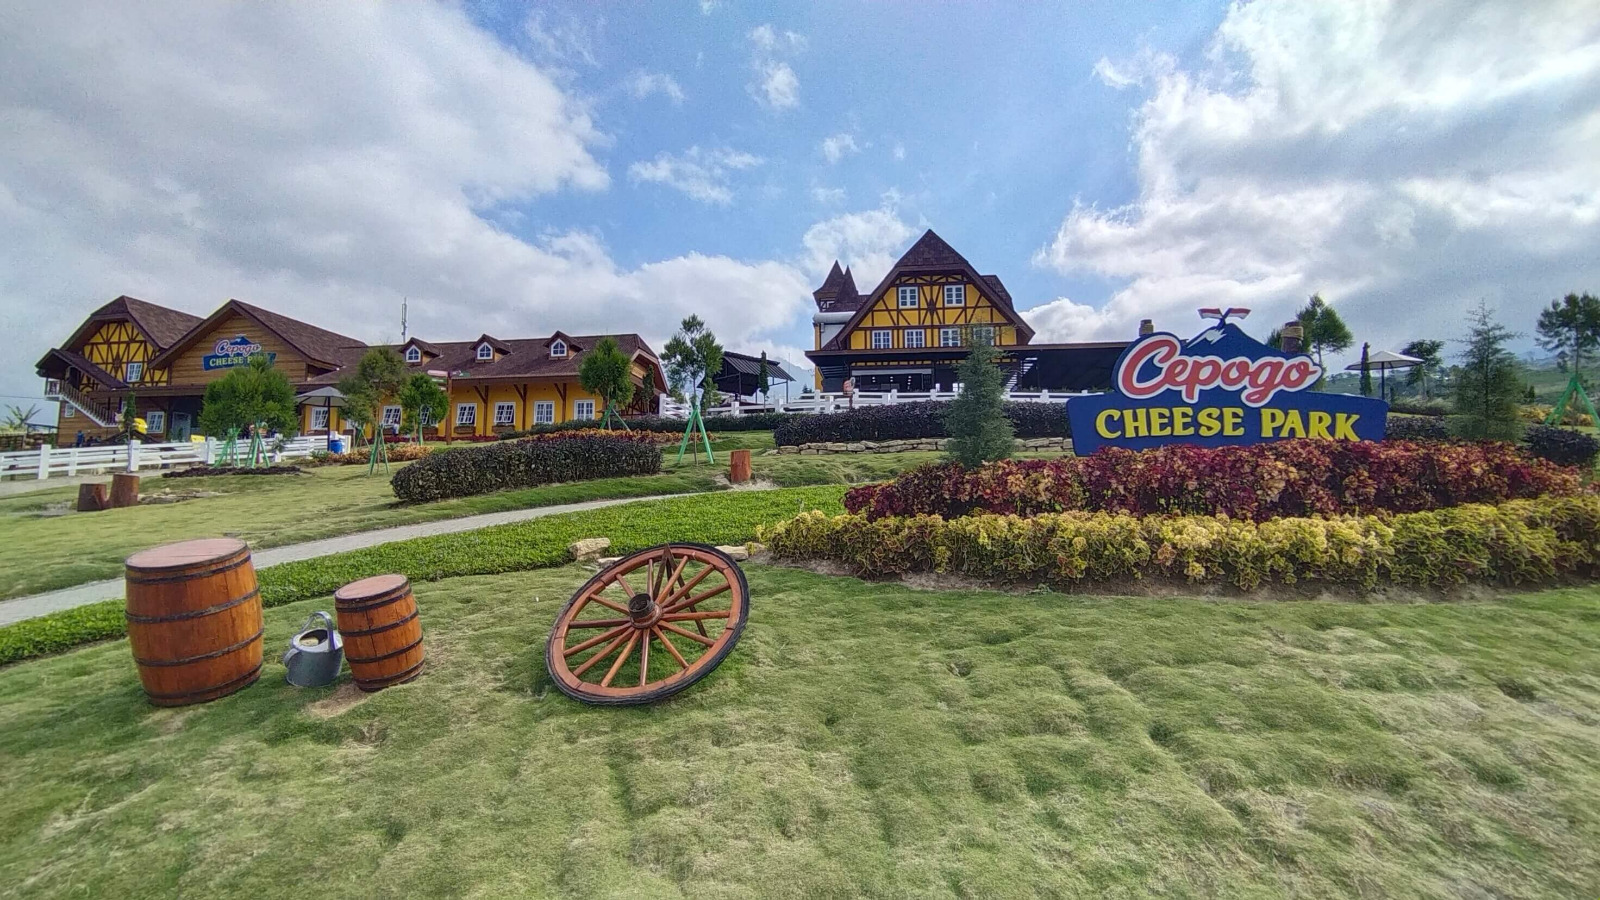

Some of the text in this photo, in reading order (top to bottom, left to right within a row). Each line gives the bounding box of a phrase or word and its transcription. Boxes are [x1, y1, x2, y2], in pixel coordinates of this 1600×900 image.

[216, 340, 261, 356] Cepogo
[209, 357, 243, 366] CHEESE
[1120, 337, 1319, 405] Cepogo
[1095, 406, 1361, 442] CHEESE PARK
